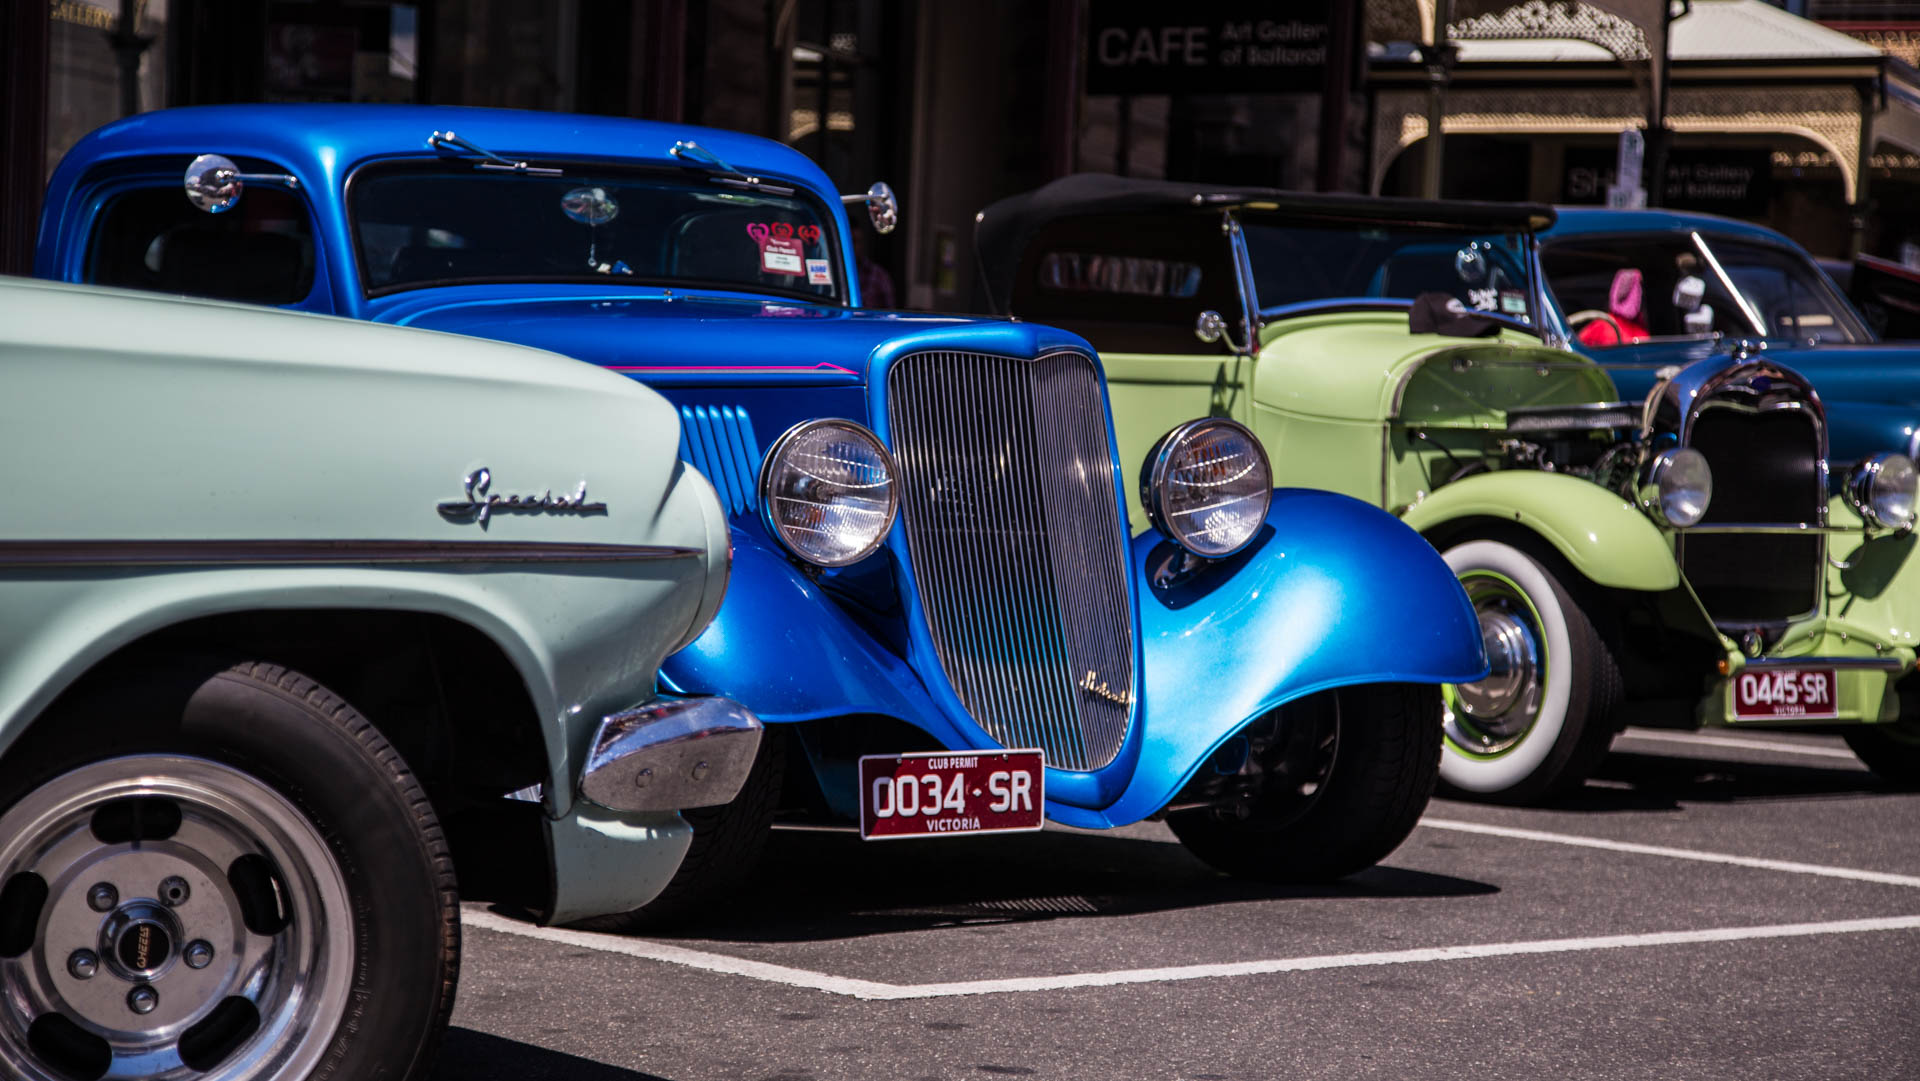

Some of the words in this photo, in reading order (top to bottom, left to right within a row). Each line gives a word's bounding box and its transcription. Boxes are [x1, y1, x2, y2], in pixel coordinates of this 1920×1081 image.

[1220, 20, 1252, 41] Art
[1098, 27, 1208, 65] CAFE
[1219, 45, 1242, 65] of
[1246, 44, 1327, 65] Ballarat
[1694, 163, 1754, 184] Gallery
[436, 467, 608, 532] Special
[928, 757, 949, 769] CLUB
[949, 756, 979, 769] PERMIT
[926, 818, 981, 832] VICTORIA
